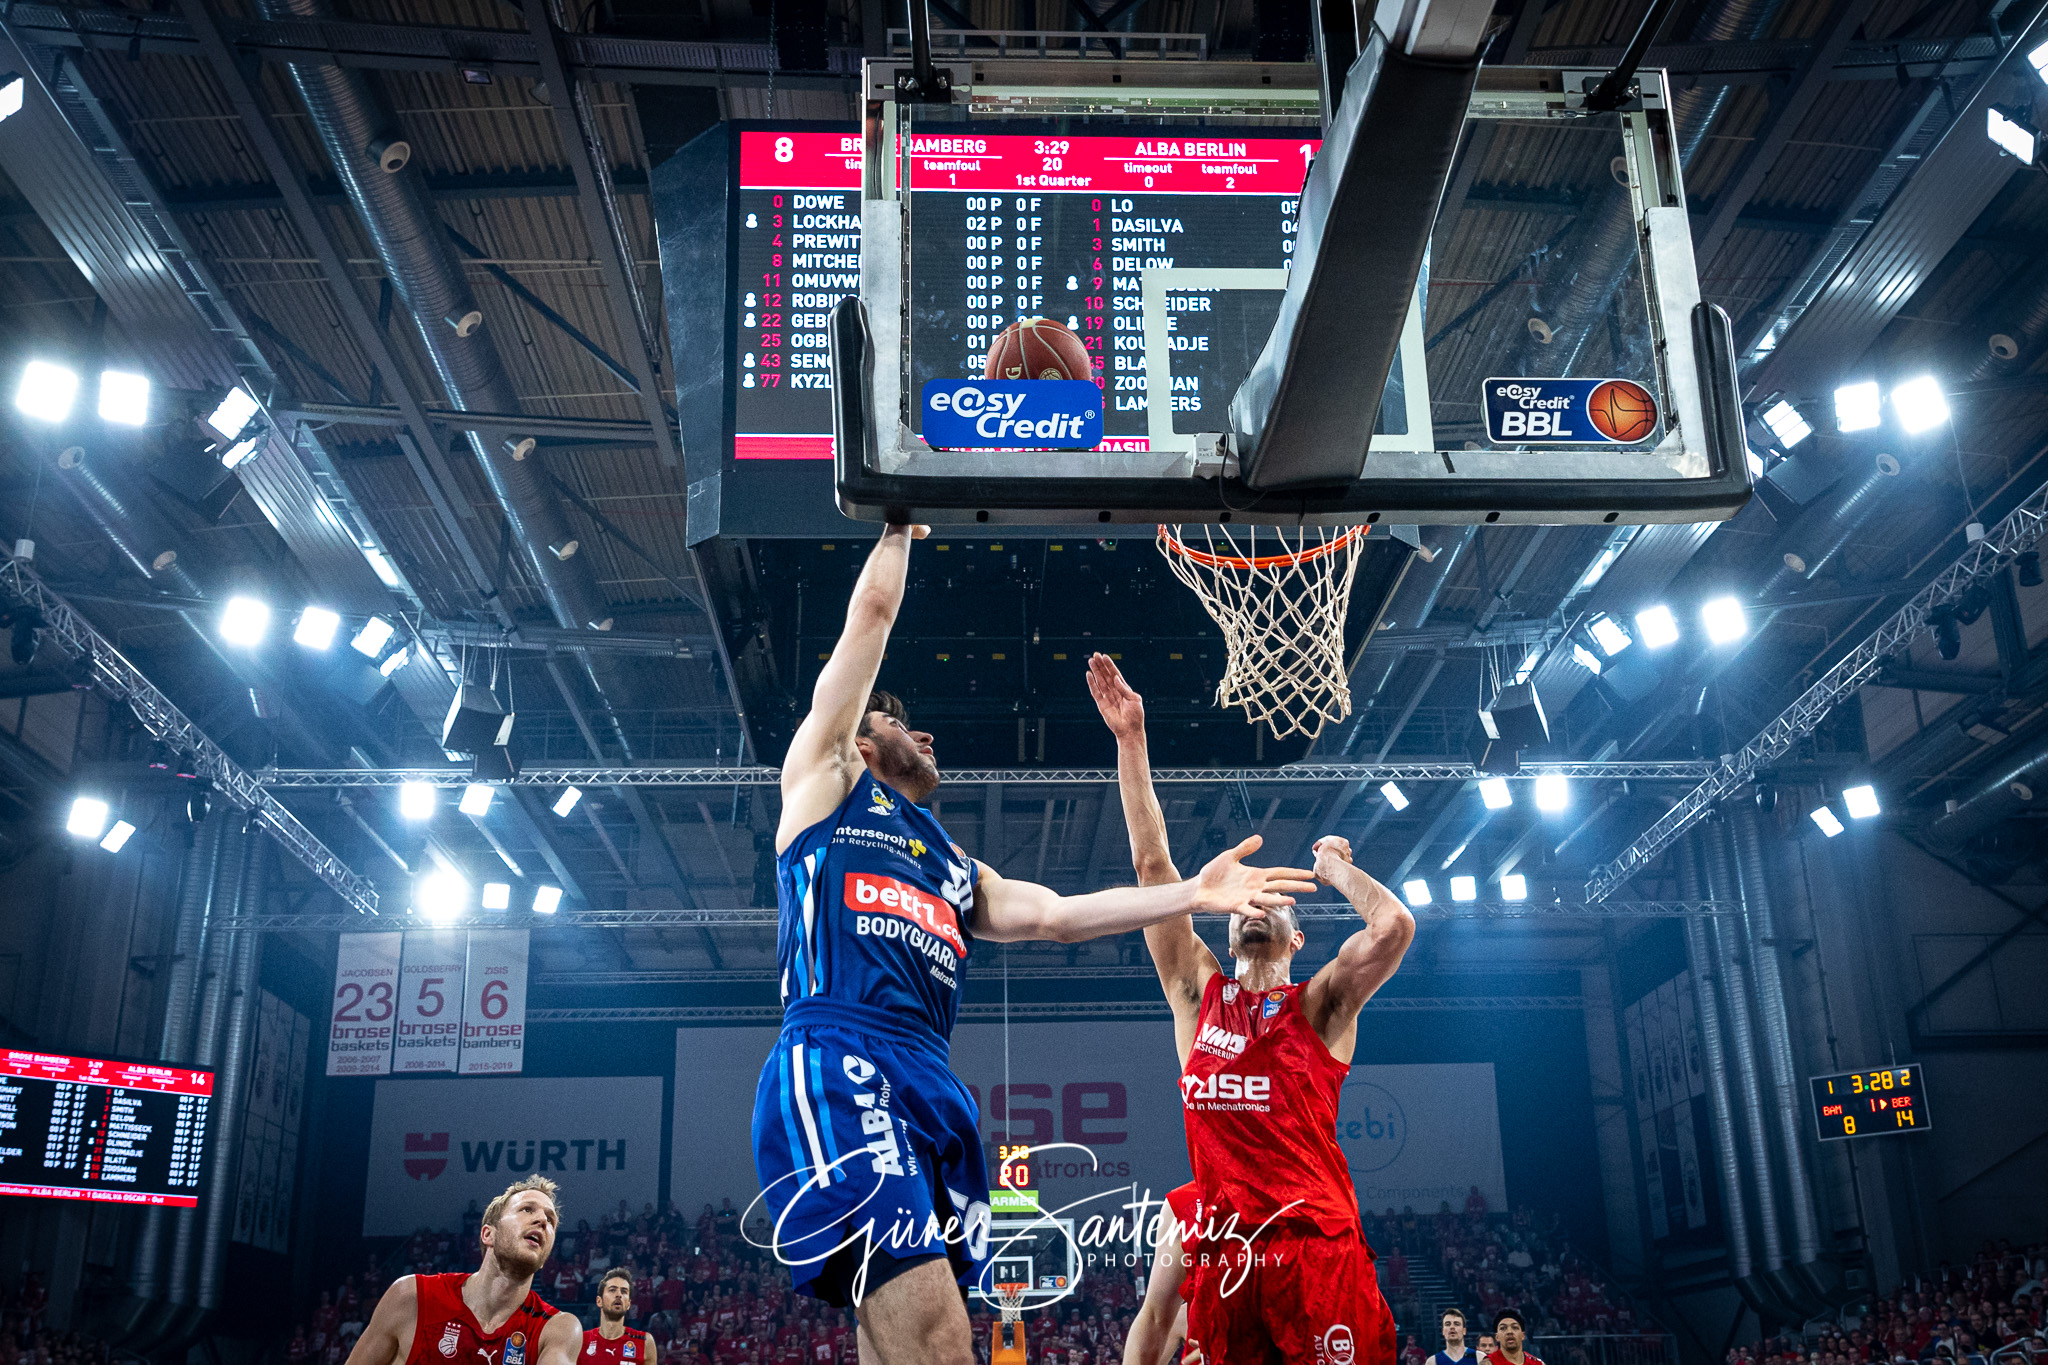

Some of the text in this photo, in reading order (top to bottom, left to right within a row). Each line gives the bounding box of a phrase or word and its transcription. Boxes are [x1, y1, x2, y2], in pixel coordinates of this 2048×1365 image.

[774, 136, 794, 163] 8
[1034, 140, 1070, 155] 3:29
[1134, 141, 1247, 157] ALBA BERLIN
[1299, 143, 1312, 169] 1
[924, 158, 981, 172] teamfoul
[1042, 156, 1063, 172] 20
[1124, 162, 1258, 175] timeout teamfoul
[949, 173, 956, 186] 1
[1015, 173, 1093, 187] 1st Quarter
[1144, 175, 1154, 189] 0
[1225, 176, 1235, 189] 2
[772, 194, 845, 210] 0 DOWE
[966, 196, 1003, 212] 00 P
[1015, 197, 1042, 212] 0 F
[1091, 198, 1133, 213] 0 LO
[772, 214, 862, 230] 3 LOCKHA
[966, 216, 1003, 231] 02 P
[1016, 217, 1042, 232] 0 F
[1092, 217, 1184, 234] 1 DASILVA
[771, 233, 861, 249] 4 PREWIT
[966, 235, 1003, 251] 00 P
[1016, 236, 1042, 251] 0 F
[1092, 237, 1166, 253] 3 SMITH
[771, 253, 860, 269] 8 MITCHE
[966, 255, 1003, 270] 00 P
[1016, 256, 1043, 271] 0 F
[1092, 256, 1174, 271] 6 DELOW
[762, 272, 859, 289] 11 OMUVW
[966, 275, 1003, 290] 00 P
[1017, 275, 1043, 290] 0 F
[1092, 276, 1103, 291] 9
[762, 293, 860, 308] 12 ROBIN
[966, 294, 1004, 310] 00 P
[1017, 295, 1043, 310] 0 F
[1084, 295, 1212, 312] 10 SCHEIDER
[760, 312, 829, 329] 22 GEB
[966, 314, 988, 330] 00
[991, 314, 1004, 330] P
[1084, 316, 1178, 330] 19 OLIE
[760, 333, 828, 348] 25 OGB
[967, 334, 986, 349] 01
[1084, 336, 1210, 351] 21 KOUADJE
[760, 353, 831, 368] 43 SEN
[1114, 356, 1146, 370] BLA
[760, 373, 831, 389] 77 KYZL
[1114, 376, 1199, 391] ZOOAN
[1116, 396, 1202, 412] LAMERS
[1501, 412, 1572, 436] BBL
[835, 826, 907, 849] nterseroh
[342, 968, 393, 978] JACOBSEN
[404, 964, 463, 974] GOLDSBERRY
[484, 966, 508, 976] ZISIS
[334, 982, 393, 1022] 23
[416, 978, 444, 1018] 5
[480, 980, 508, 1020] 6
[332, 1024, 390, 1039] brose
[400, 1020, 458, 1036] brose
[464, 1022, 522, 1037] brose
[331, 1040, 390, 1052] baskets
[398, 1036, 456, 1048] baskets
[462, 1038, 521, 1050] bamberg
[190, 1073, 205, 1086] 14
[1828, 1070, 1910, 1094] 1 3.28 2
[1208, 1102, 1270, 1112] Mechatronics
[1822, 1096, 1912, 1116] BAM 1 BER
[1843, 1110, 1914, 1134] 8 14
[853, 1092, 904, 1176] ALBA
[462, 1139, 626, 1173] WÜRTH
[1038, 1160, 1130, 1178] tronics
[990, 1196, 1036, 1206] ARMER
